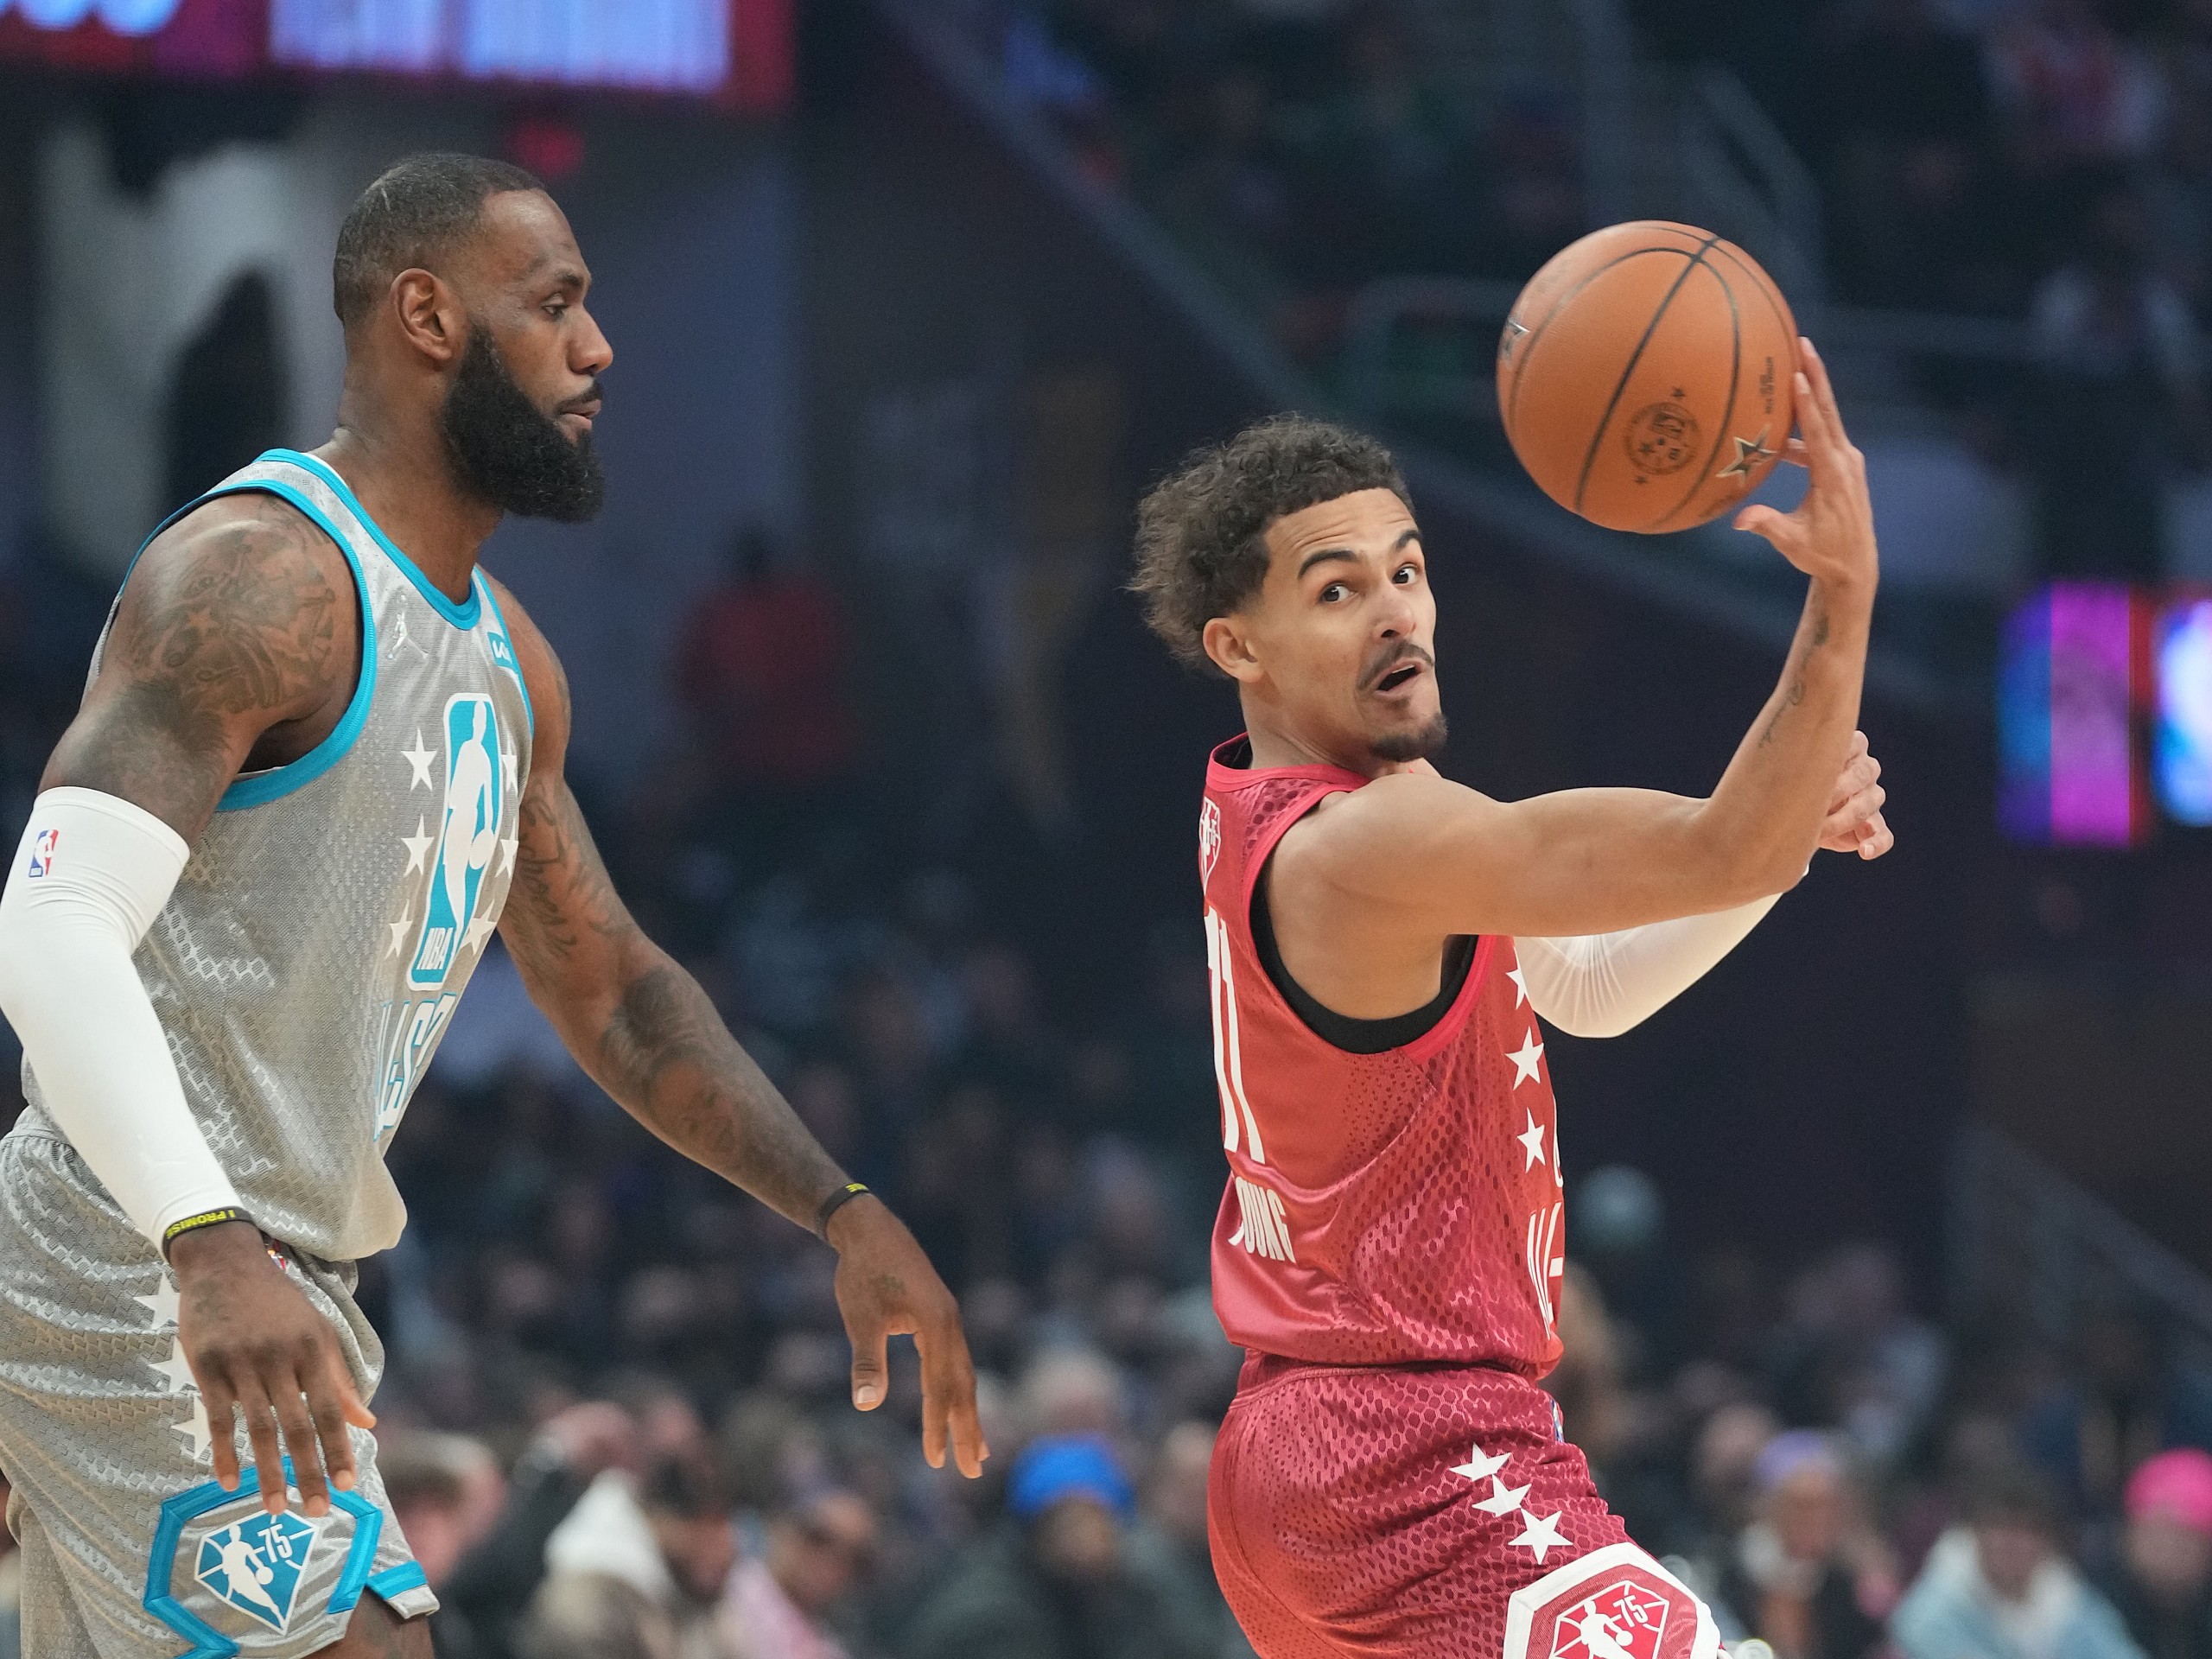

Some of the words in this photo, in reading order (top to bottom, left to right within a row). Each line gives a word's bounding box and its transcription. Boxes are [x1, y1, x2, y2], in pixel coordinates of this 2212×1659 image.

[416, 926, 454, 970] NBA
[227, 1210, 236, 1218] I
[1228, 1176, 1296, 1263] OUNG
[257, 1522, 293, 1562] 75
[1612, 1594, 1649, 1629] 75
